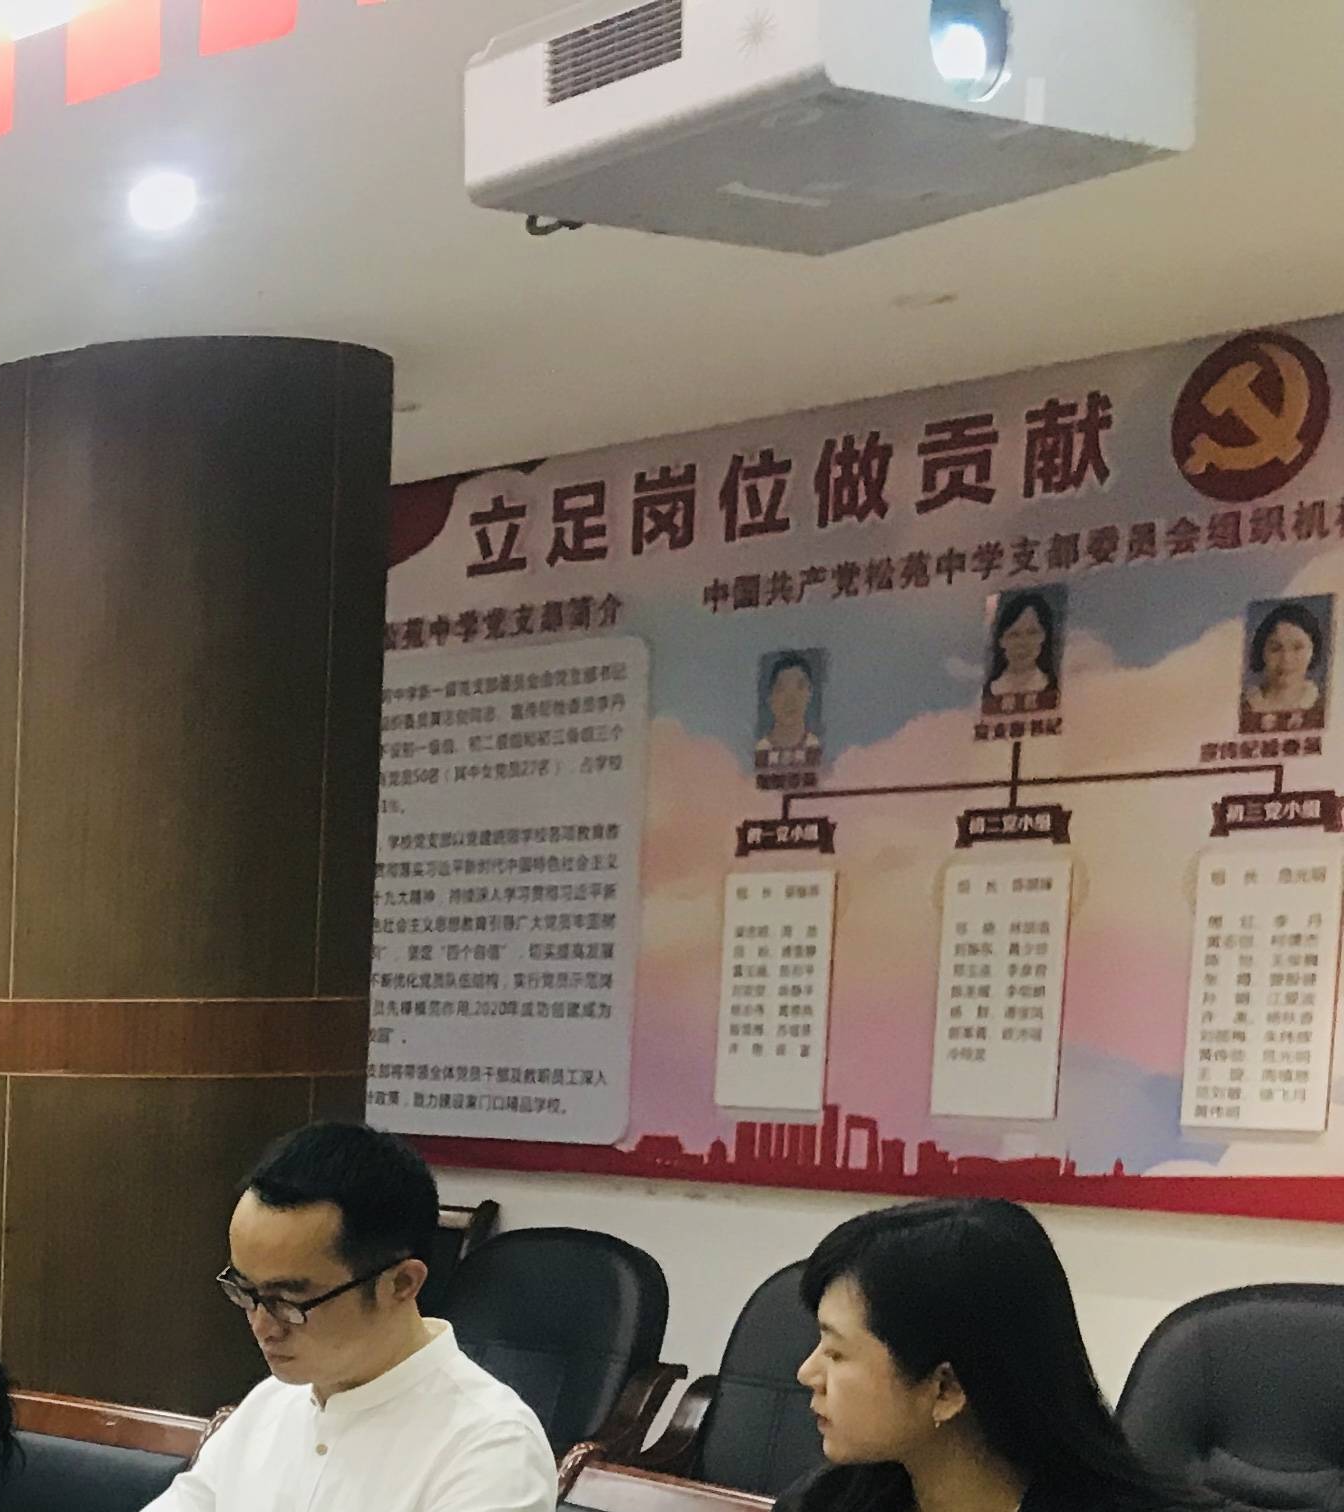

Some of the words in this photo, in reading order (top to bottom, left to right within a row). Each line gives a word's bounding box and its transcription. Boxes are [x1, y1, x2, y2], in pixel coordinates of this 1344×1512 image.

[466, 392, 1113, 577] 立足岗位做贡献
